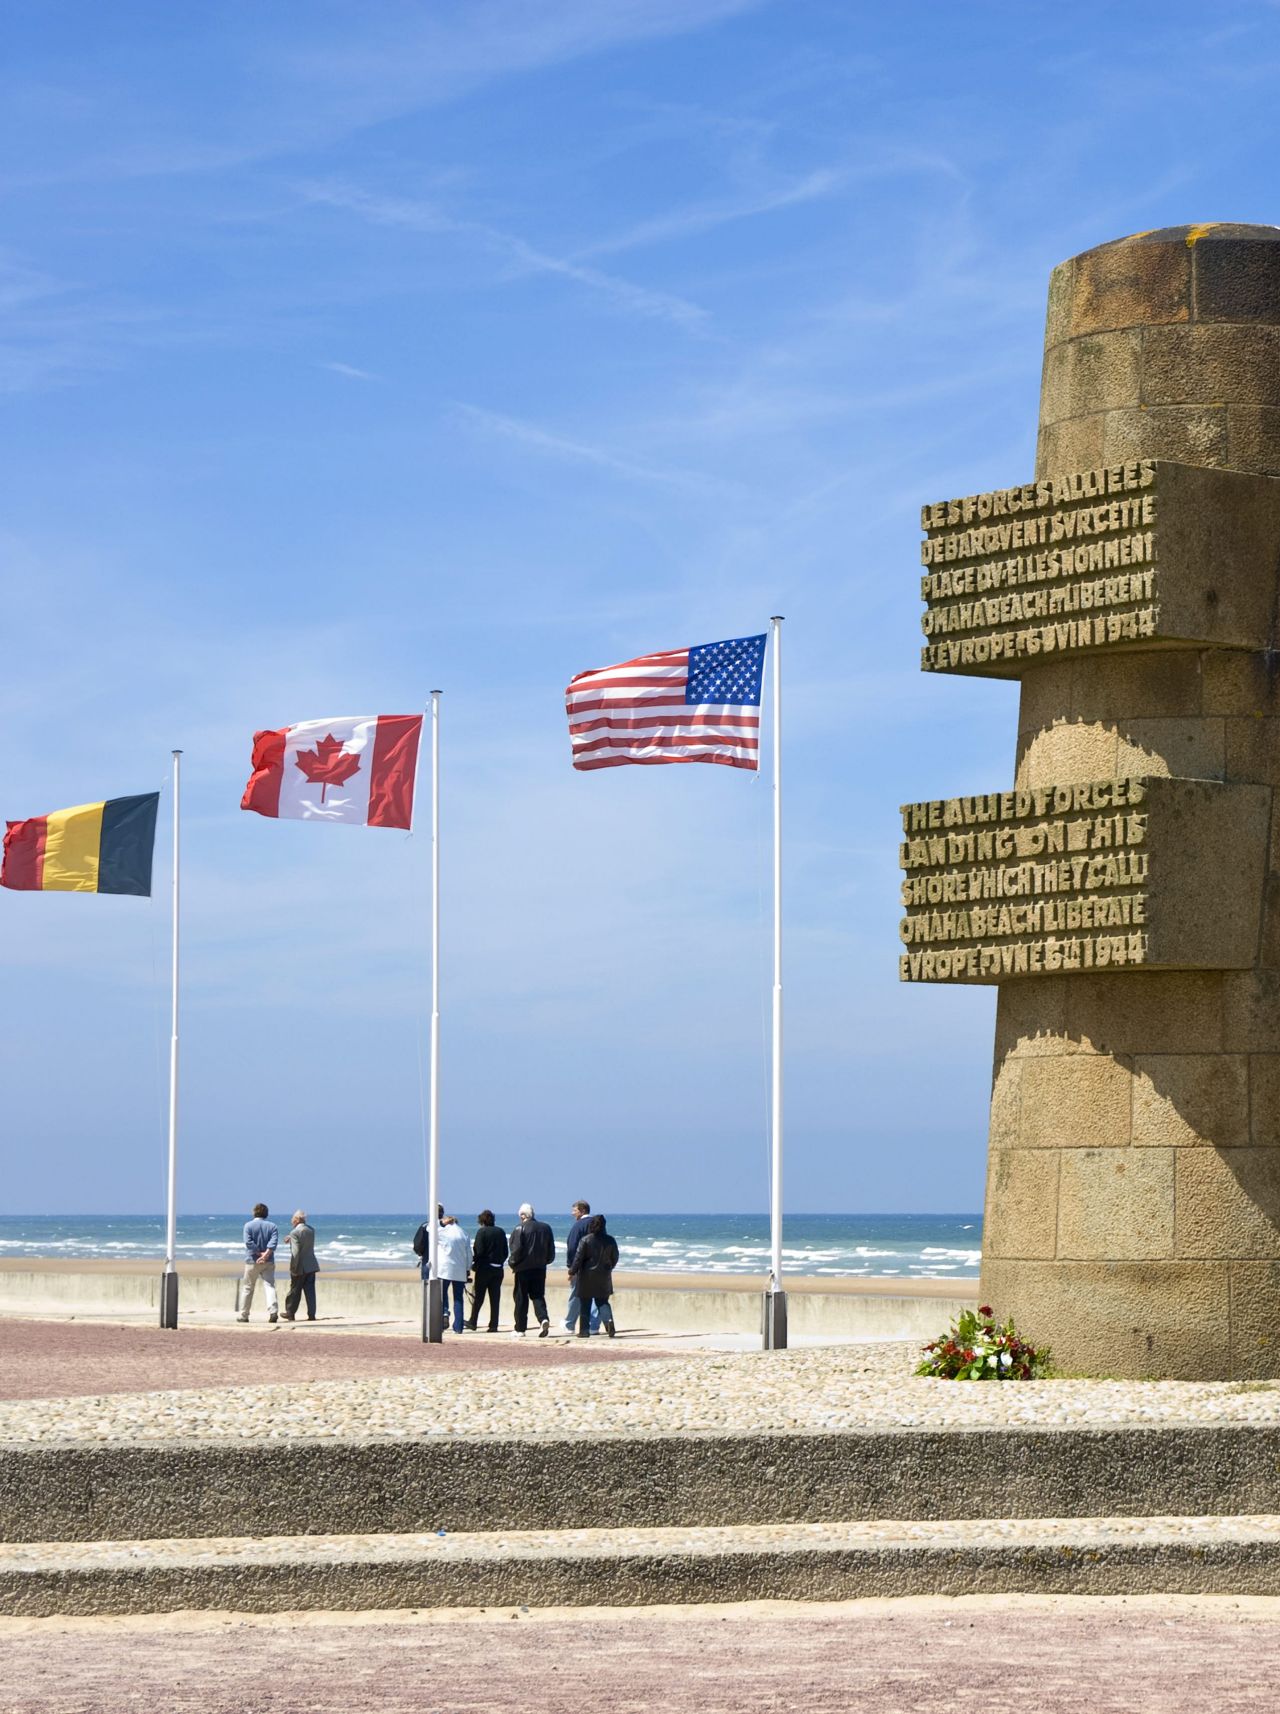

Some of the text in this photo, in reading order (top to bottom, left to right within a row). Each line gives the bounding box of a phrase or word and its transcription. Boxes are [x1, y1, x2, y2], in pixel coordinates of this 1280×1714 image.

[921, 460, 1157, 530] LES FORCES ALLIEES
[1093, 495, 1157, 534] CETTE
[921, 565, 978, 601] PLAGE
[1061, 533, 1155, 576] NOMMENT
[921, 599, 987, 635] OMAHA
[985, 589, 1049, 626] BEACH
[1063, 570, 1156, 612] LIBERENT
[1094, 611, 1156, 645] 1944
[900, 777, 1147, 832] THE ALLIED FORCES
[900, 814, 1147, 869] LANDING ON THIS
[901, 854, 1148, 906] SHORE WHICH THEY CALL
[900, 895, 1147, 944] OMAHA BEACH LIBERATE
[1084, 935, 1146, 967] 1944
